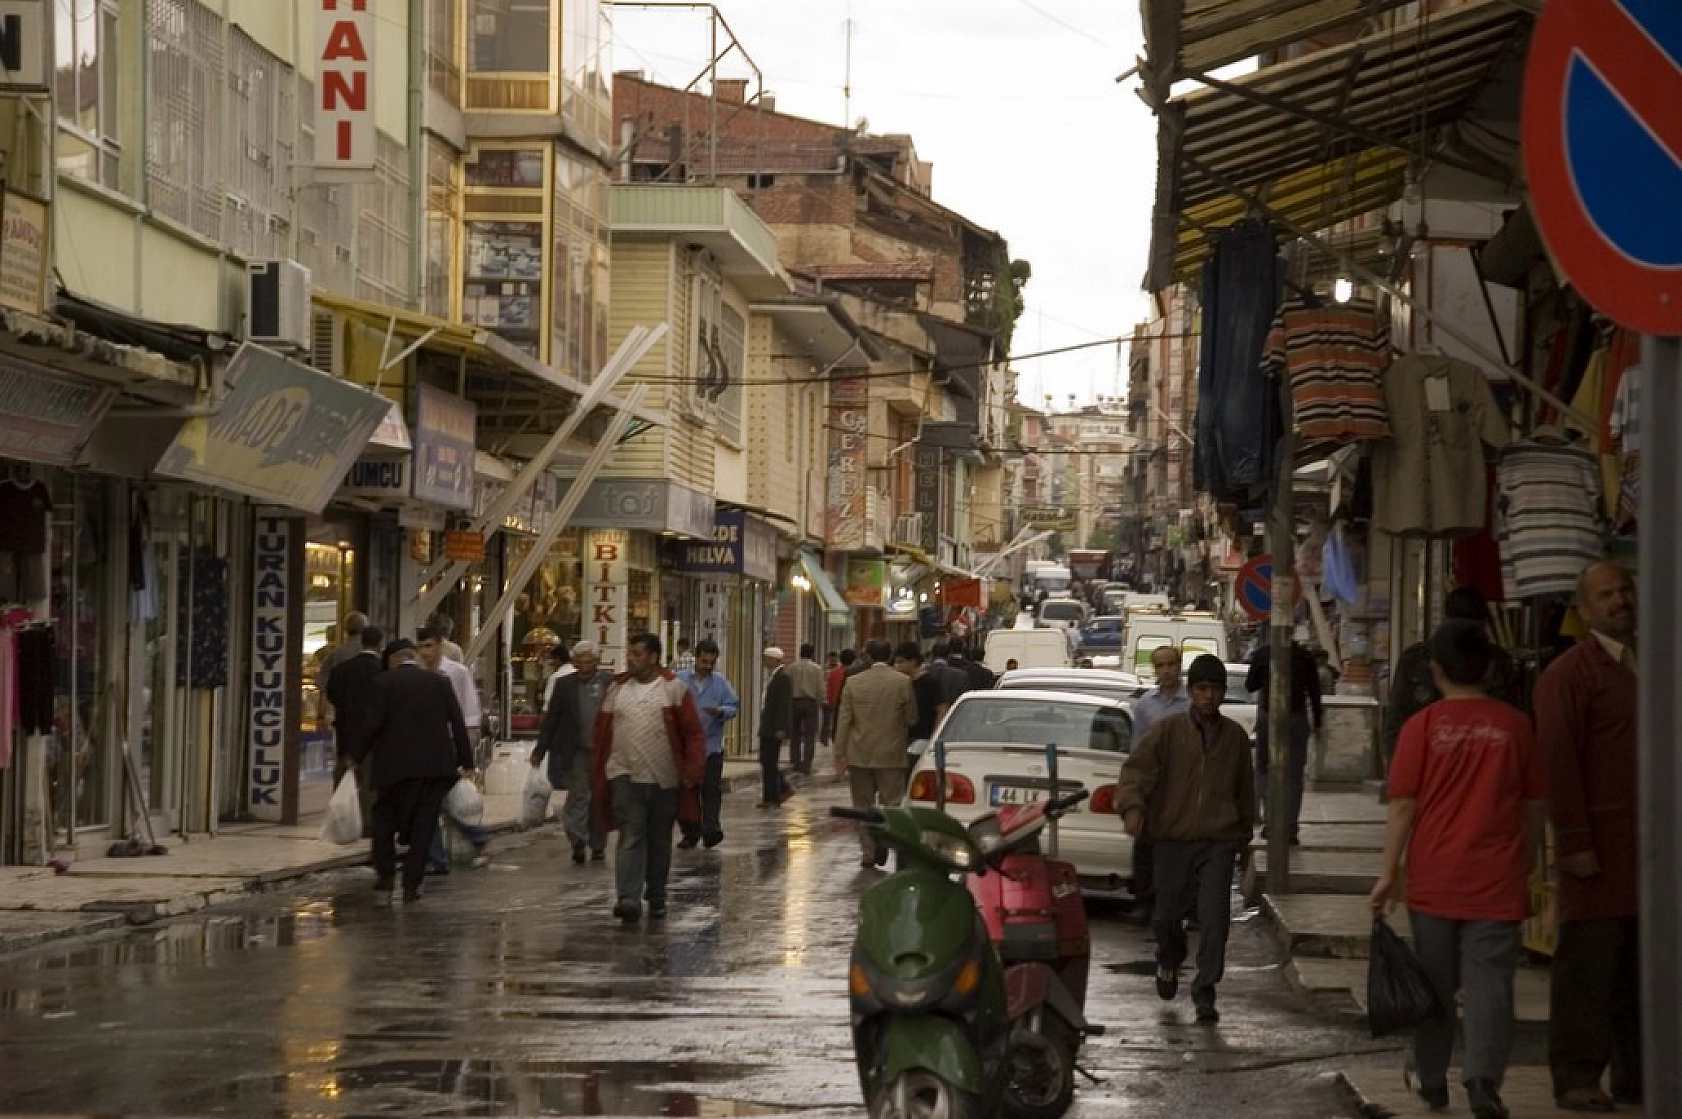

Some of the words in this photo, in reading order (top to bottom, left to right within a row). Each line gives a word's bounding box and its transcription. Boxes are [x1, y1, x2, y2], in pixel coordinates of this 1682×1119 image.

[321, 0, 367, 160] ANI
[344, 462, 403, 487] UMCU
[258, 517, 286, 607] TURAN
[686, 545, 735, 565] HELVA
[252, 617, 285, 804] KUYUMCULUK
